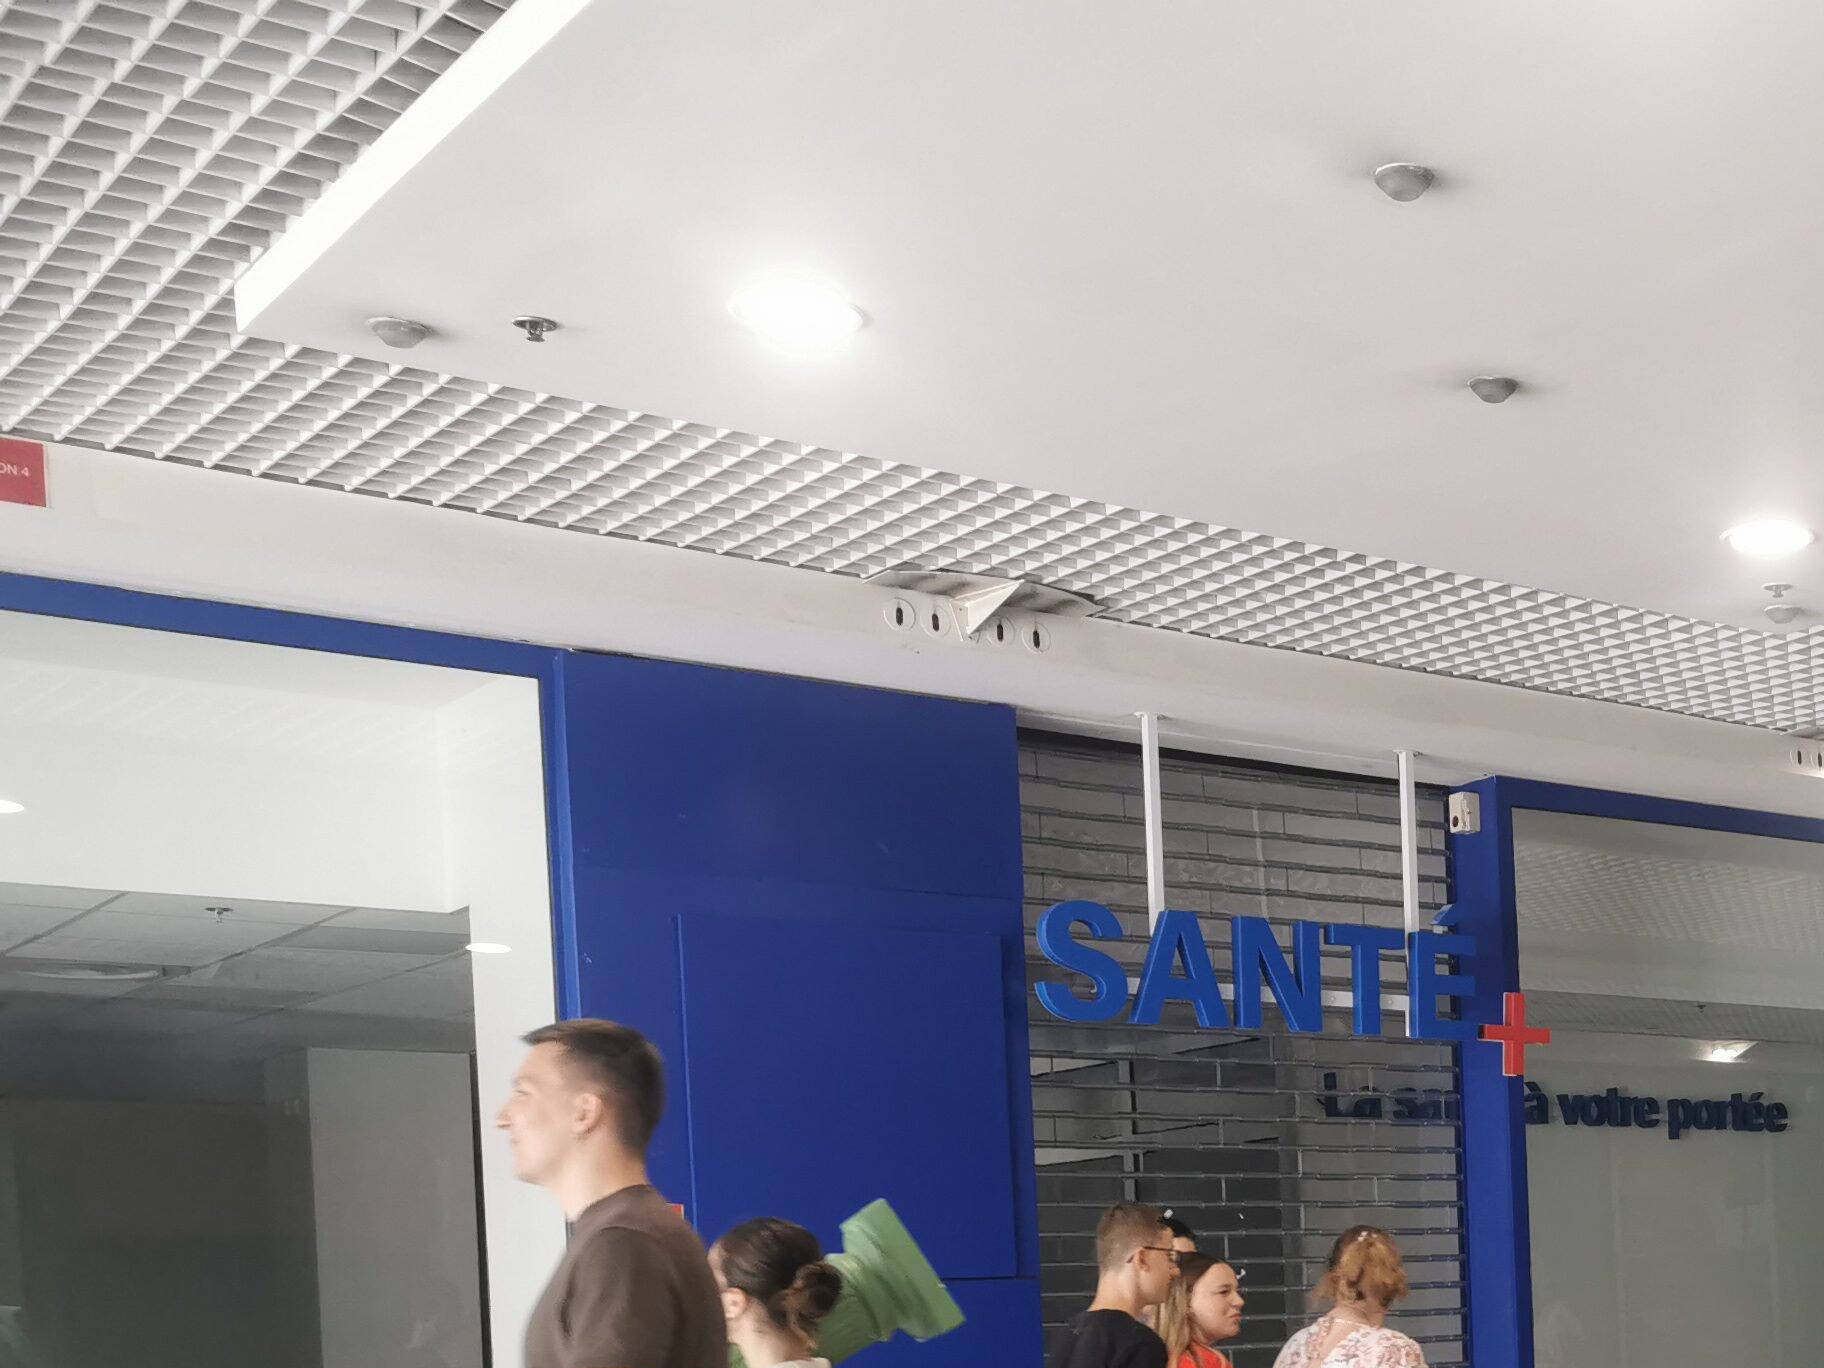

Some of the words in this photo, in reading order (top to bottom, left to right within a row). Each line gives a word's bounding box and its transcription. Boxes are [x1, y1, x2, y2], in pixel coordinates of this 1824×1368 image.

[1034, 899, 1481, 1040] SANTÉ
[1524, 1081, 1549, 1125] à
[1556, 1087, 1660, 1128] votre
[1667, 1091, 1788, 1139] portée
